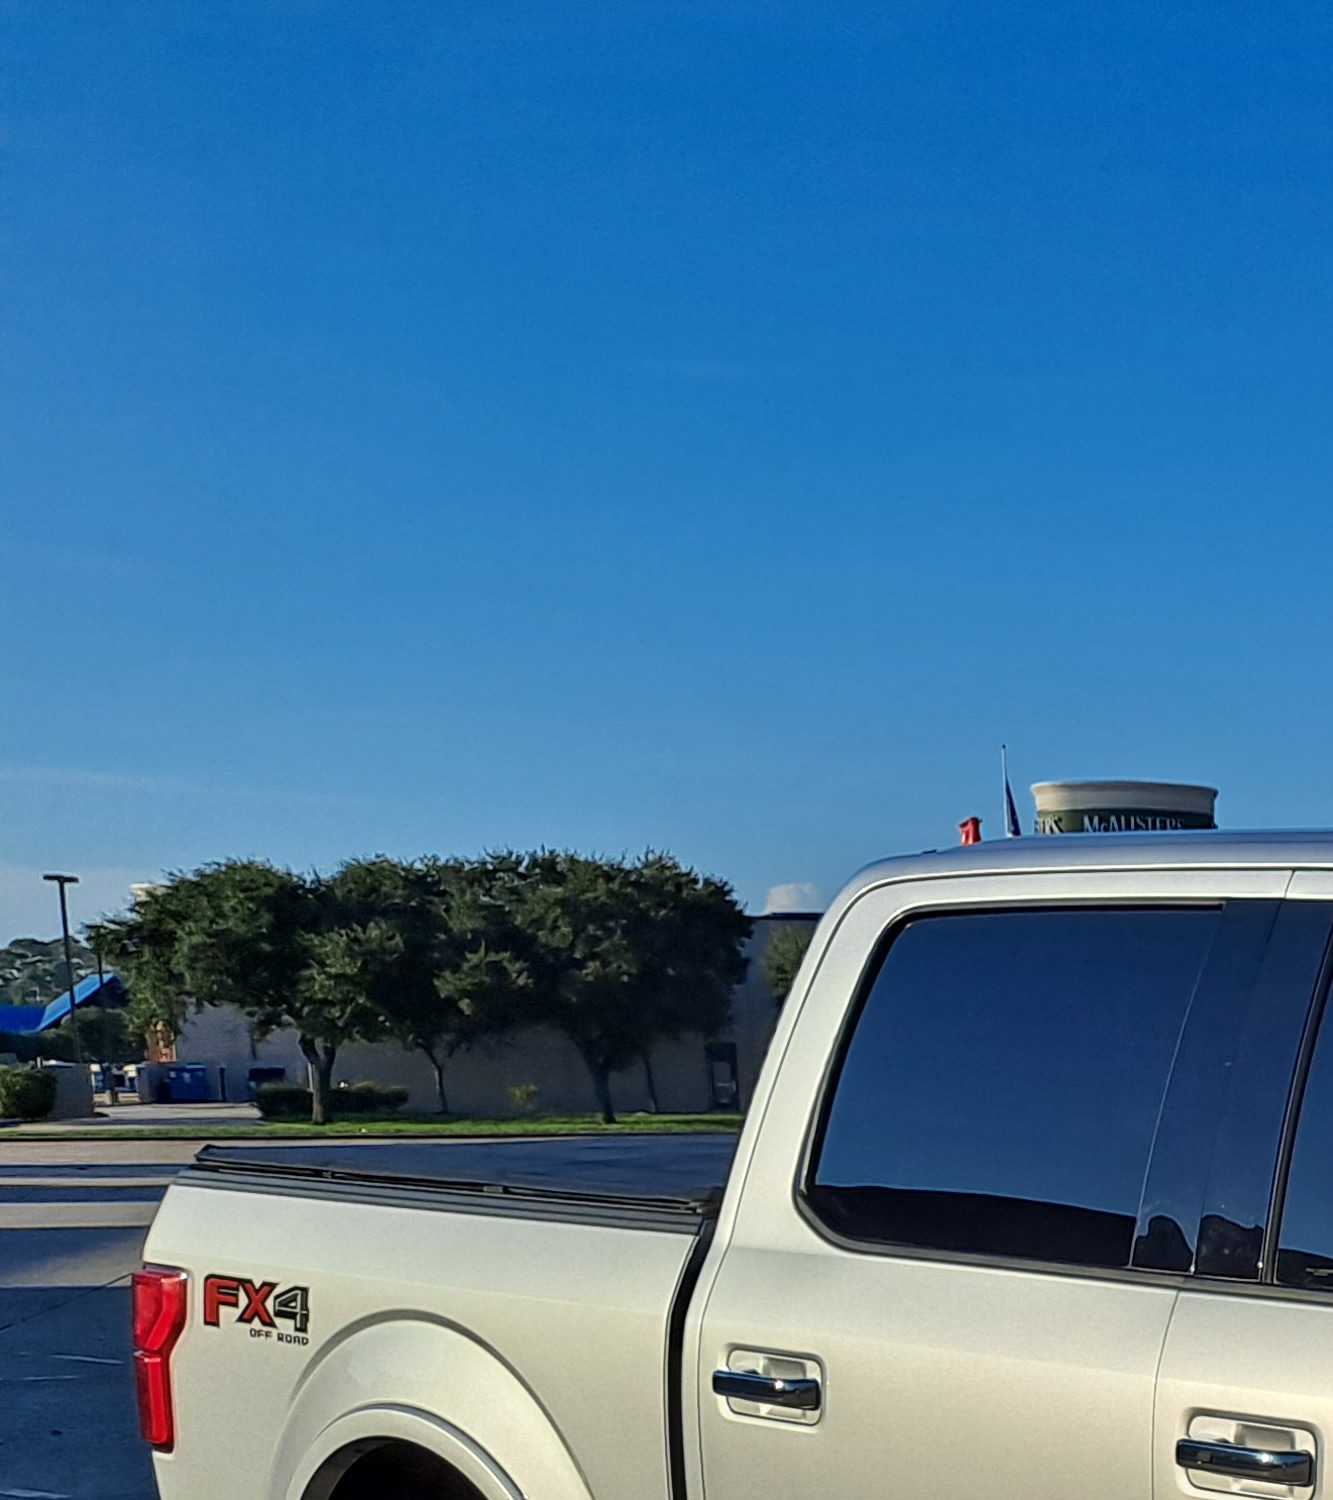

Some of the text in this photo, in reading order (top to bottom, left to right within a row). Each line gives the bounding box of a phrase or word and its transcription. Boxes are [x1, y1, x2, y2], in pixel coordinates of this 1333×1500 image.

[204, 1274, 309, 1334] FX4
[249, 1328, 309, 1346] OFF ROAD
